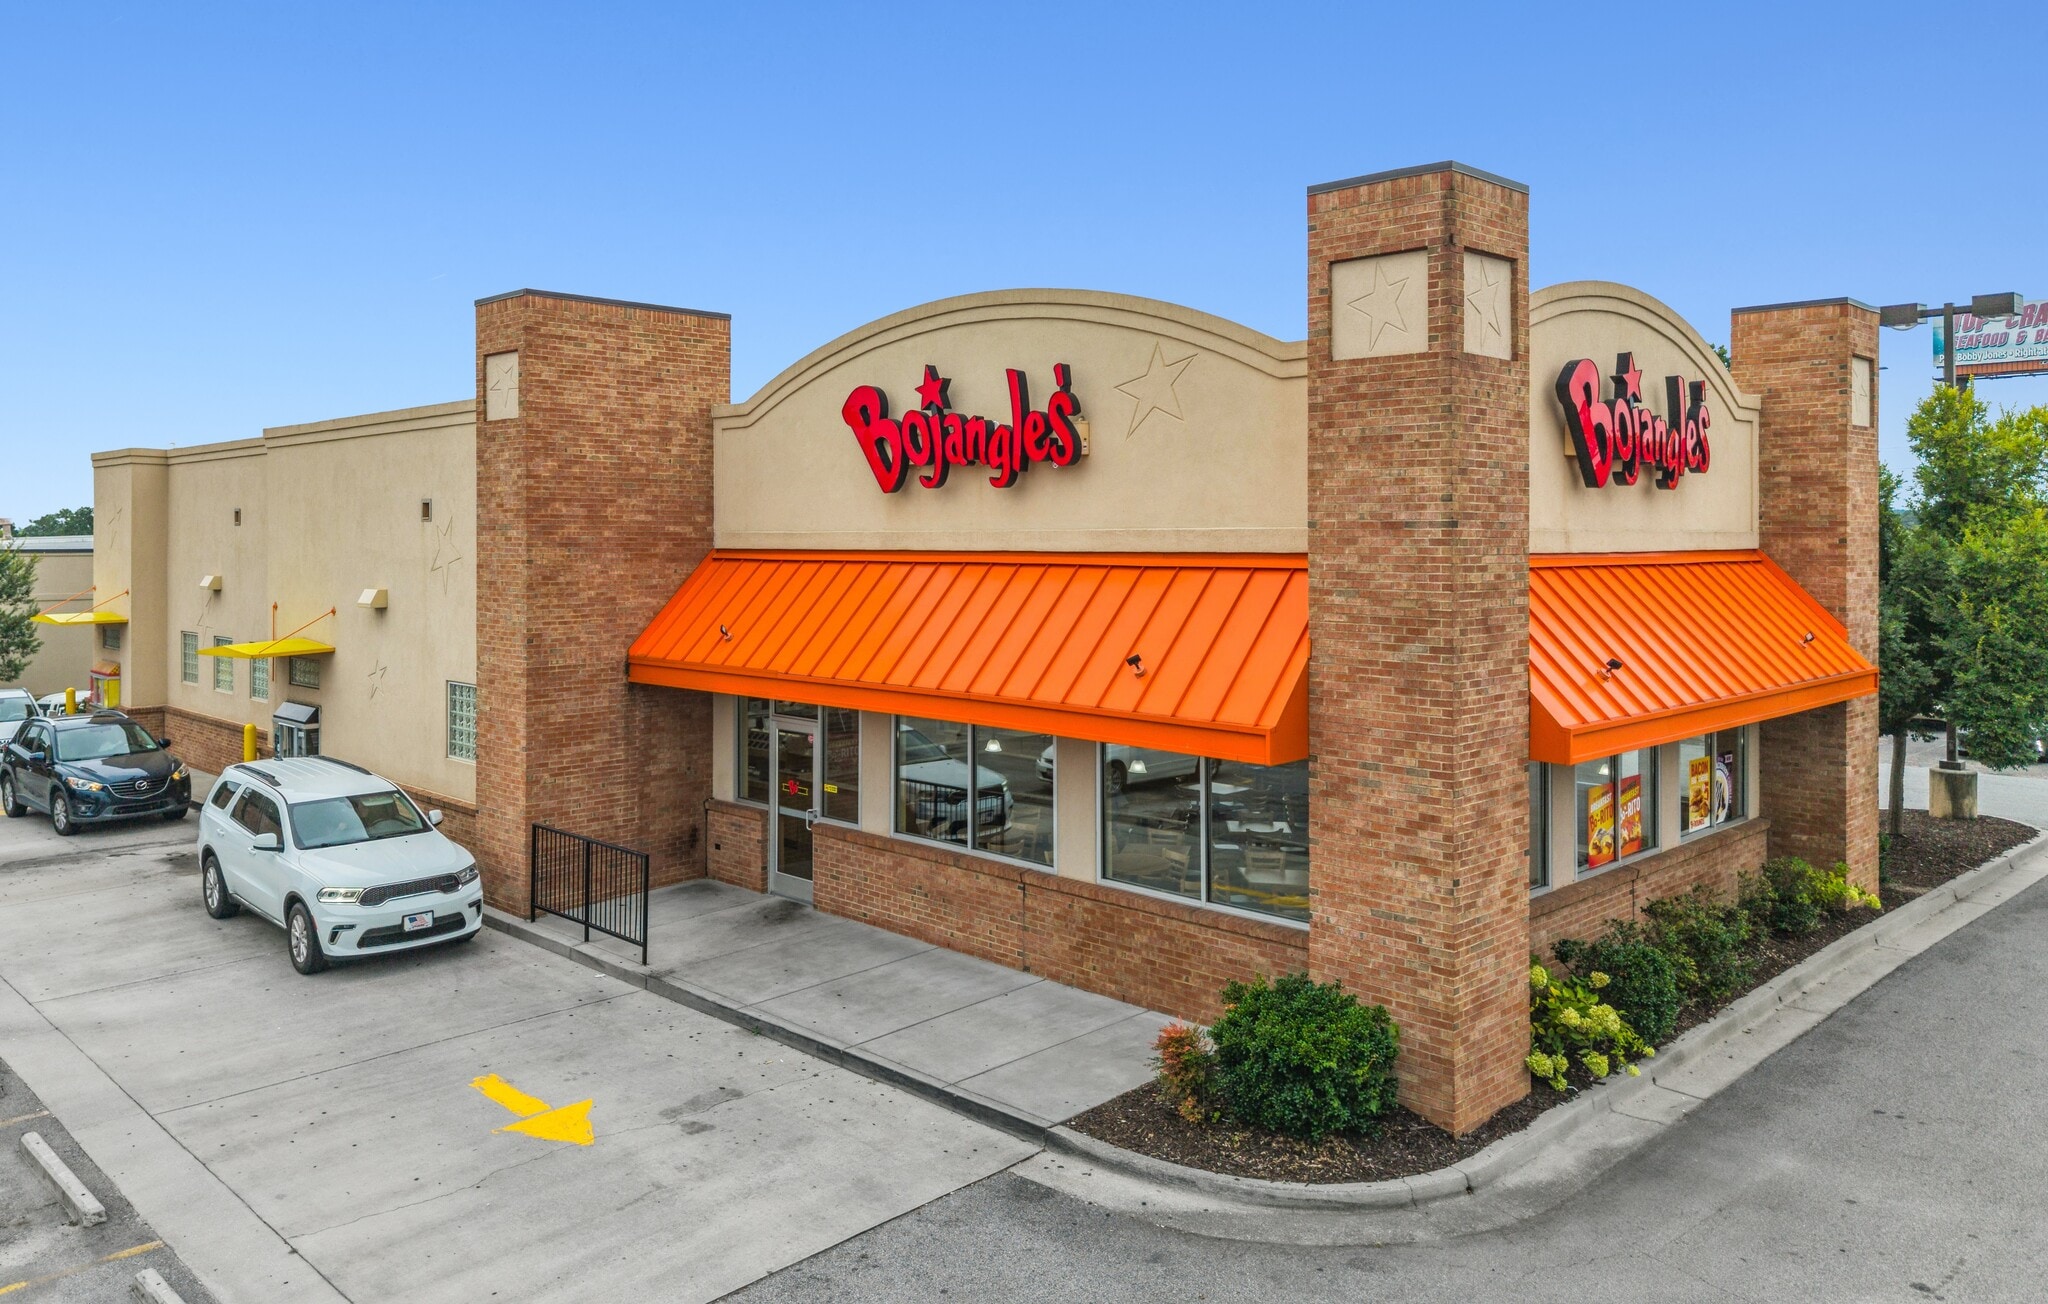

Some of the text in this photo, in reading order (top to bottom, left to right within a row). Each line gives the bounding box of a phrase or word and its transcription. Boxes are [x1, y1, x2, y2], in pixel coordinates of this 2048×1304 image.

[1957, 351, 1983, 362] Bobby
[1984, 349, 2007, 360] Jones
[2015, 347, 2037, 359] Right
